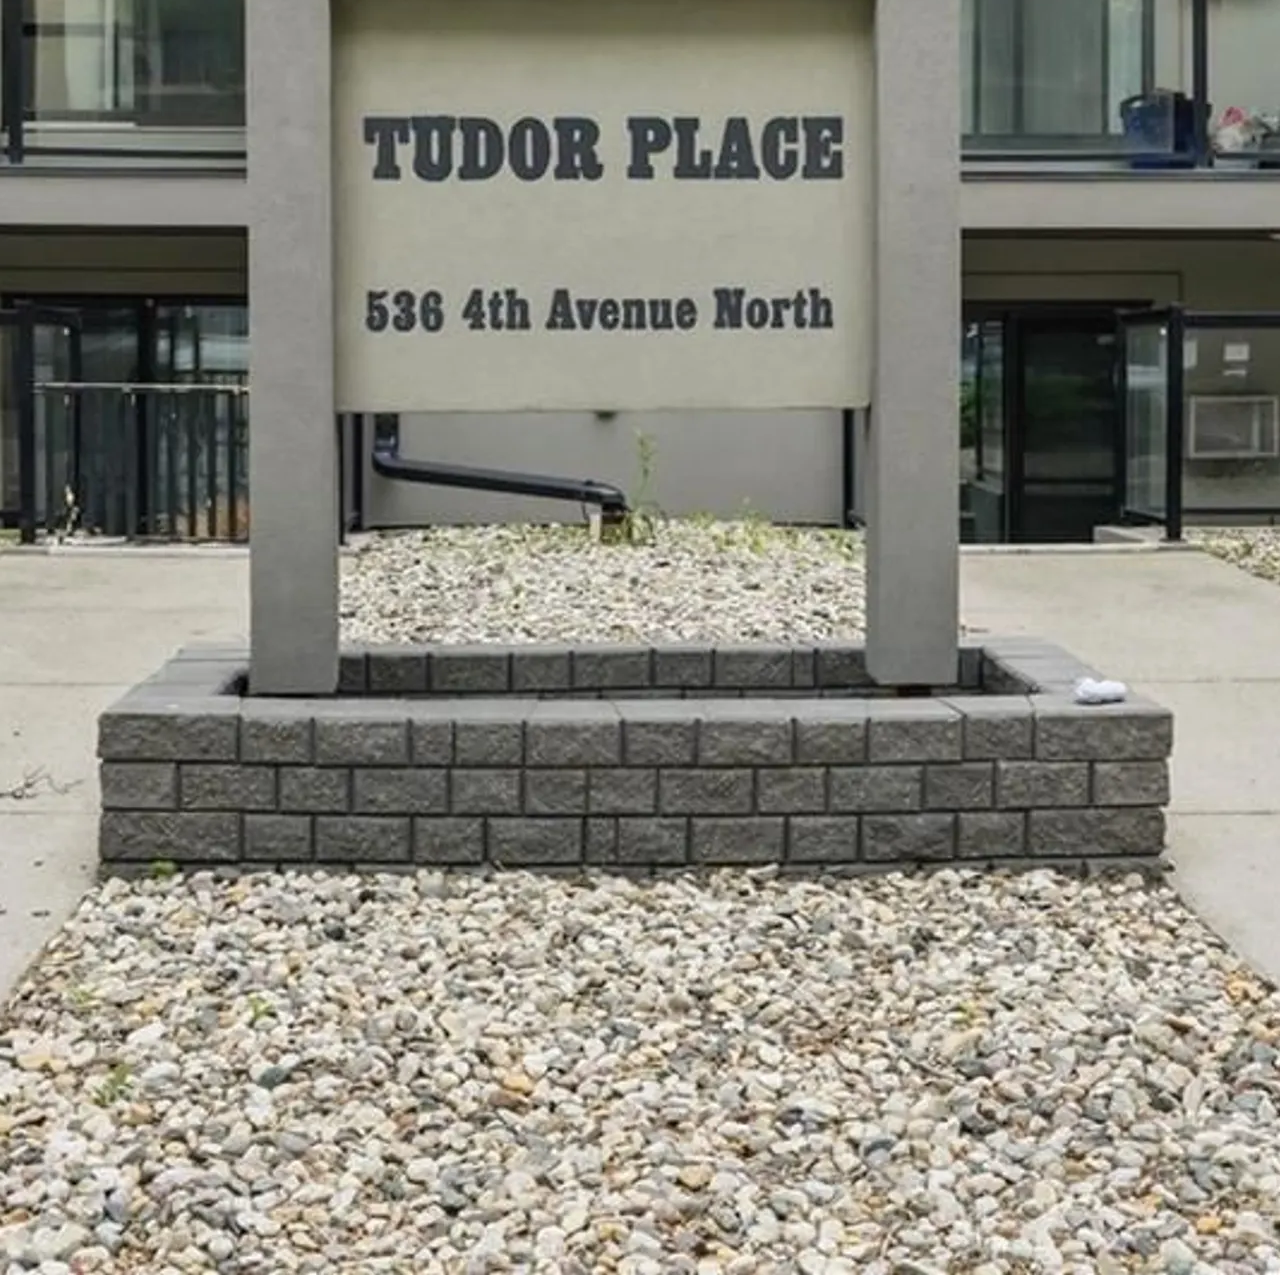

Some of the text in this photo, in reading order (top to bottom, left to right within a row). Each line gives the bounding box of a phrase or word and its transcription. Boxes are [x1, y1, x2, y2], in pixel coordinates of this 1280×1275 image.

[362, 115, 845, 182] TUDOR PLACE
[365, 287, 835, 333] 536 4th Avenue North
